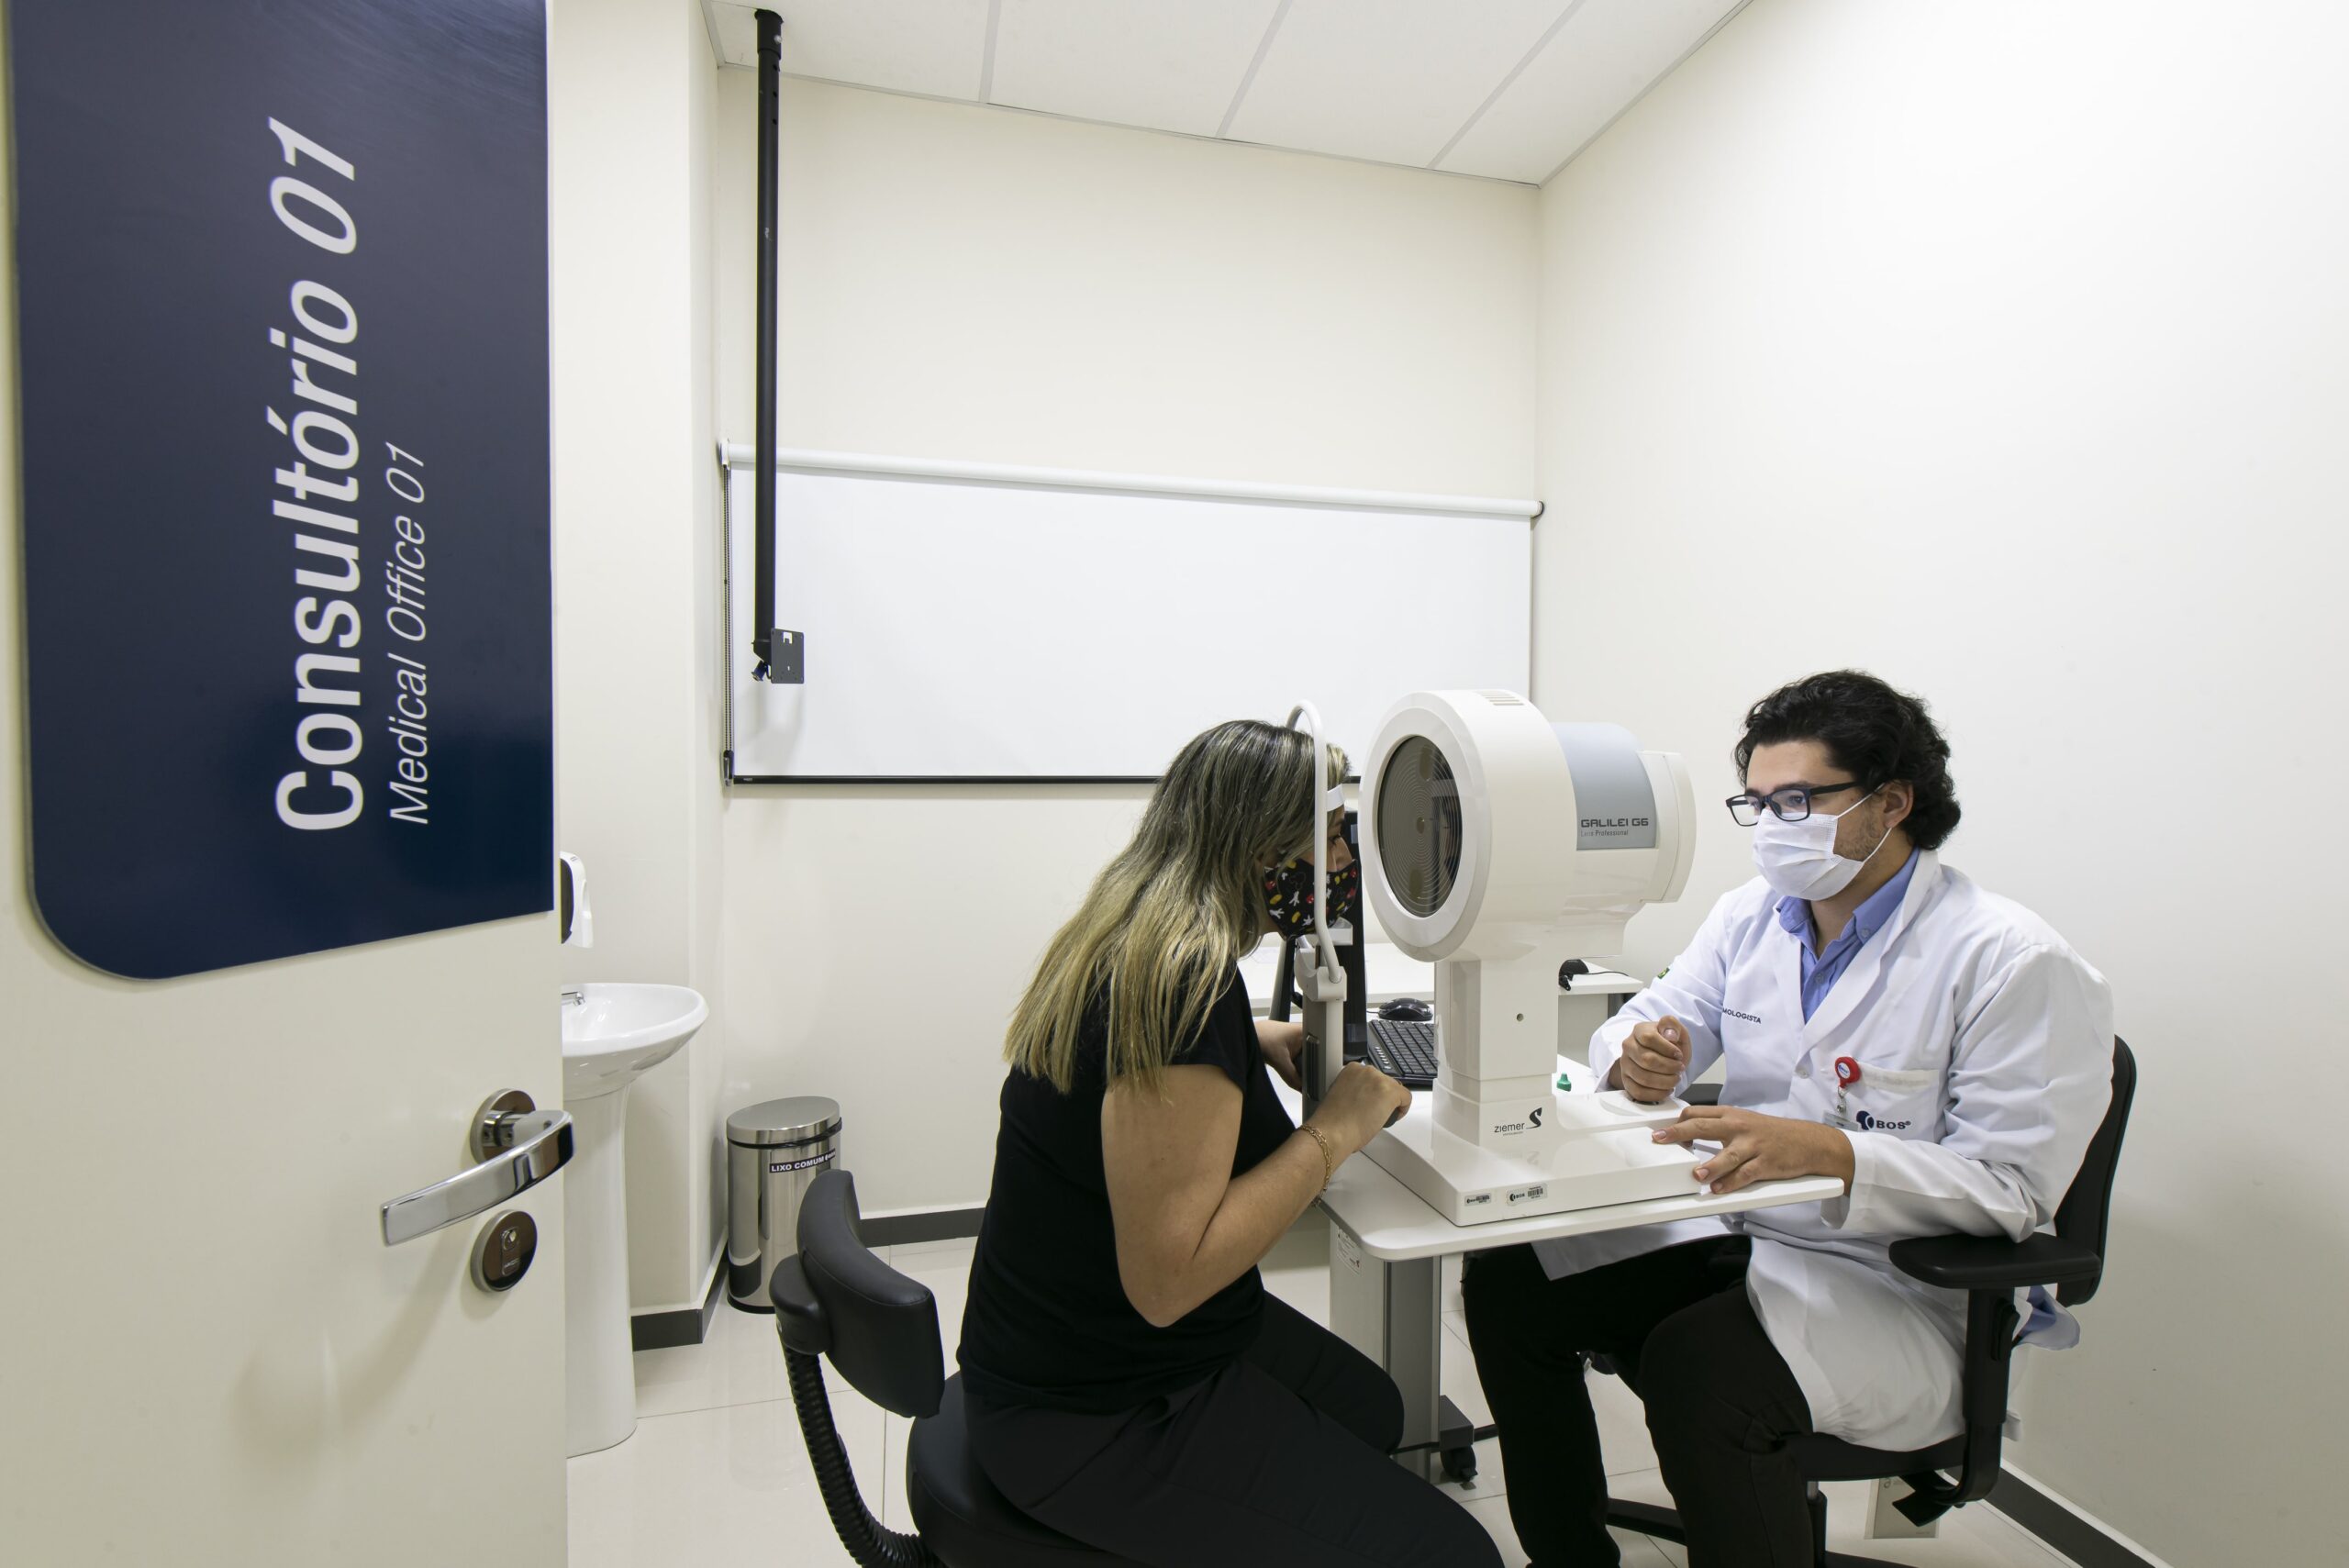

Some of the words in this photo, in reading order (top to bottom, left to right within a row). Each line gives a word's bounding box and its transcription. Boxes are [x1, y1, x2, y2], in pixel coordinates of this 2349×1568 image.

[268, 117, 357, 255] 01
[385, 441, 425, 504] 01
[267, 280, 364, 831] Consultório
[385, 515, 427, 642] Office
[387, 652, 429, 825] Medical
[1580, 818, 1629, 828] GALILEI
[1631, 817, 1649, 827] G6
[1595, 828, 1629, 837] Professional
[1494, 1122, 1525, 1133] ziemer
[771, 1163, 792, 1172] LIXO
[795, 1156, 824, 1170] COMUM
